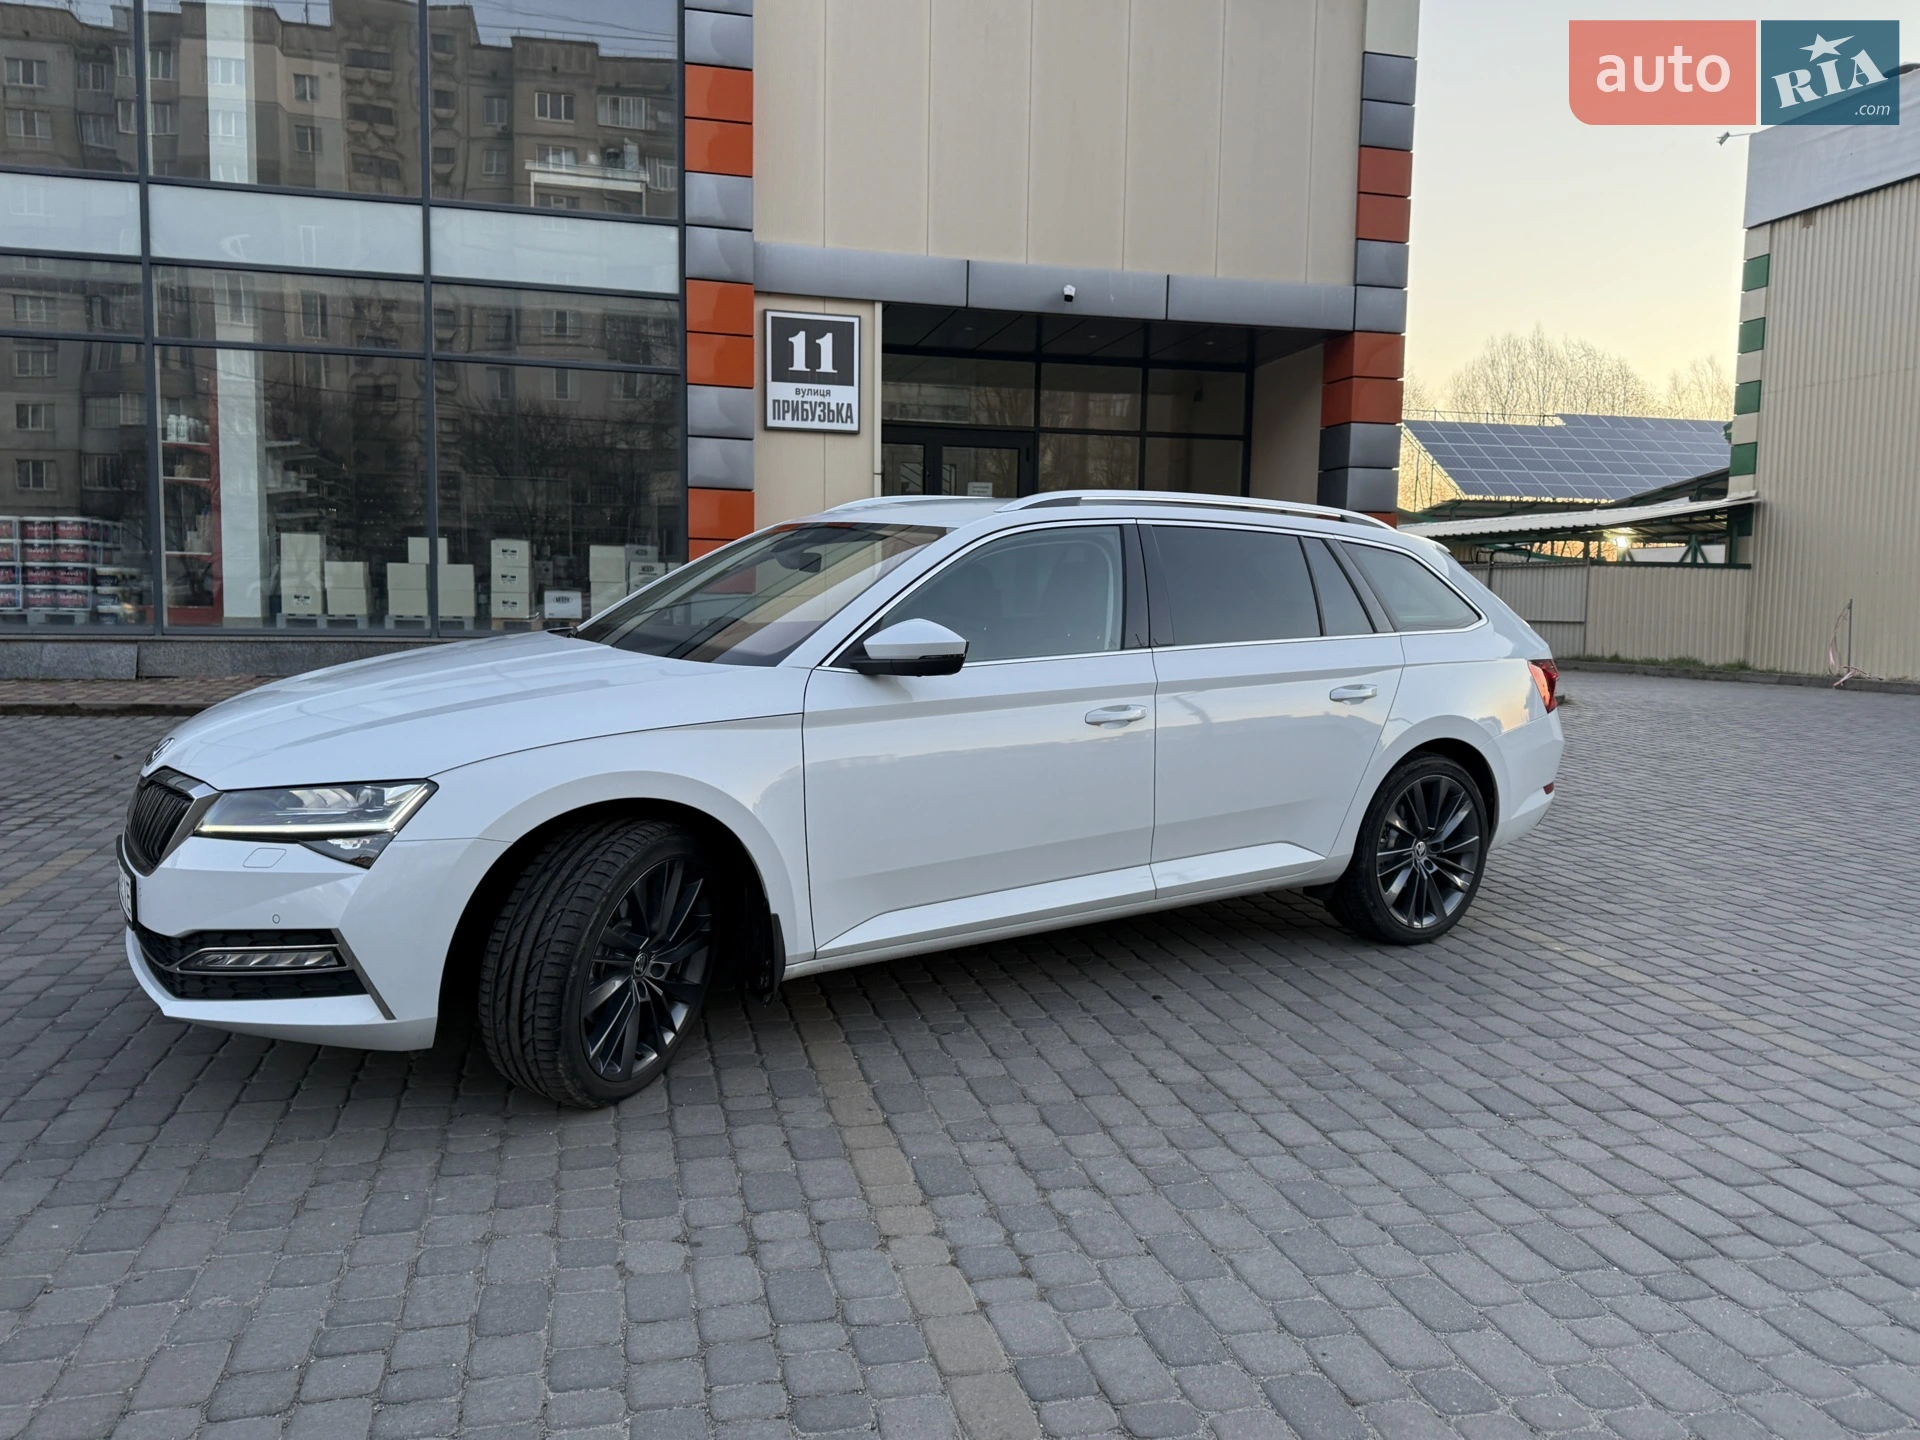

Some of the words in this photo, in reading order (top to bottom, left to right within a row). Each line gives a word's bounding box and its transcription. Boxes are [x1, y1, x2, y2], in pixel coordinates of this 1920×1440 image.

[788, 330, 838, 373] 11
[795, 387, 831, 398] вулиця
[772, 399, 854, 424] ПРИБУЗЬКА
